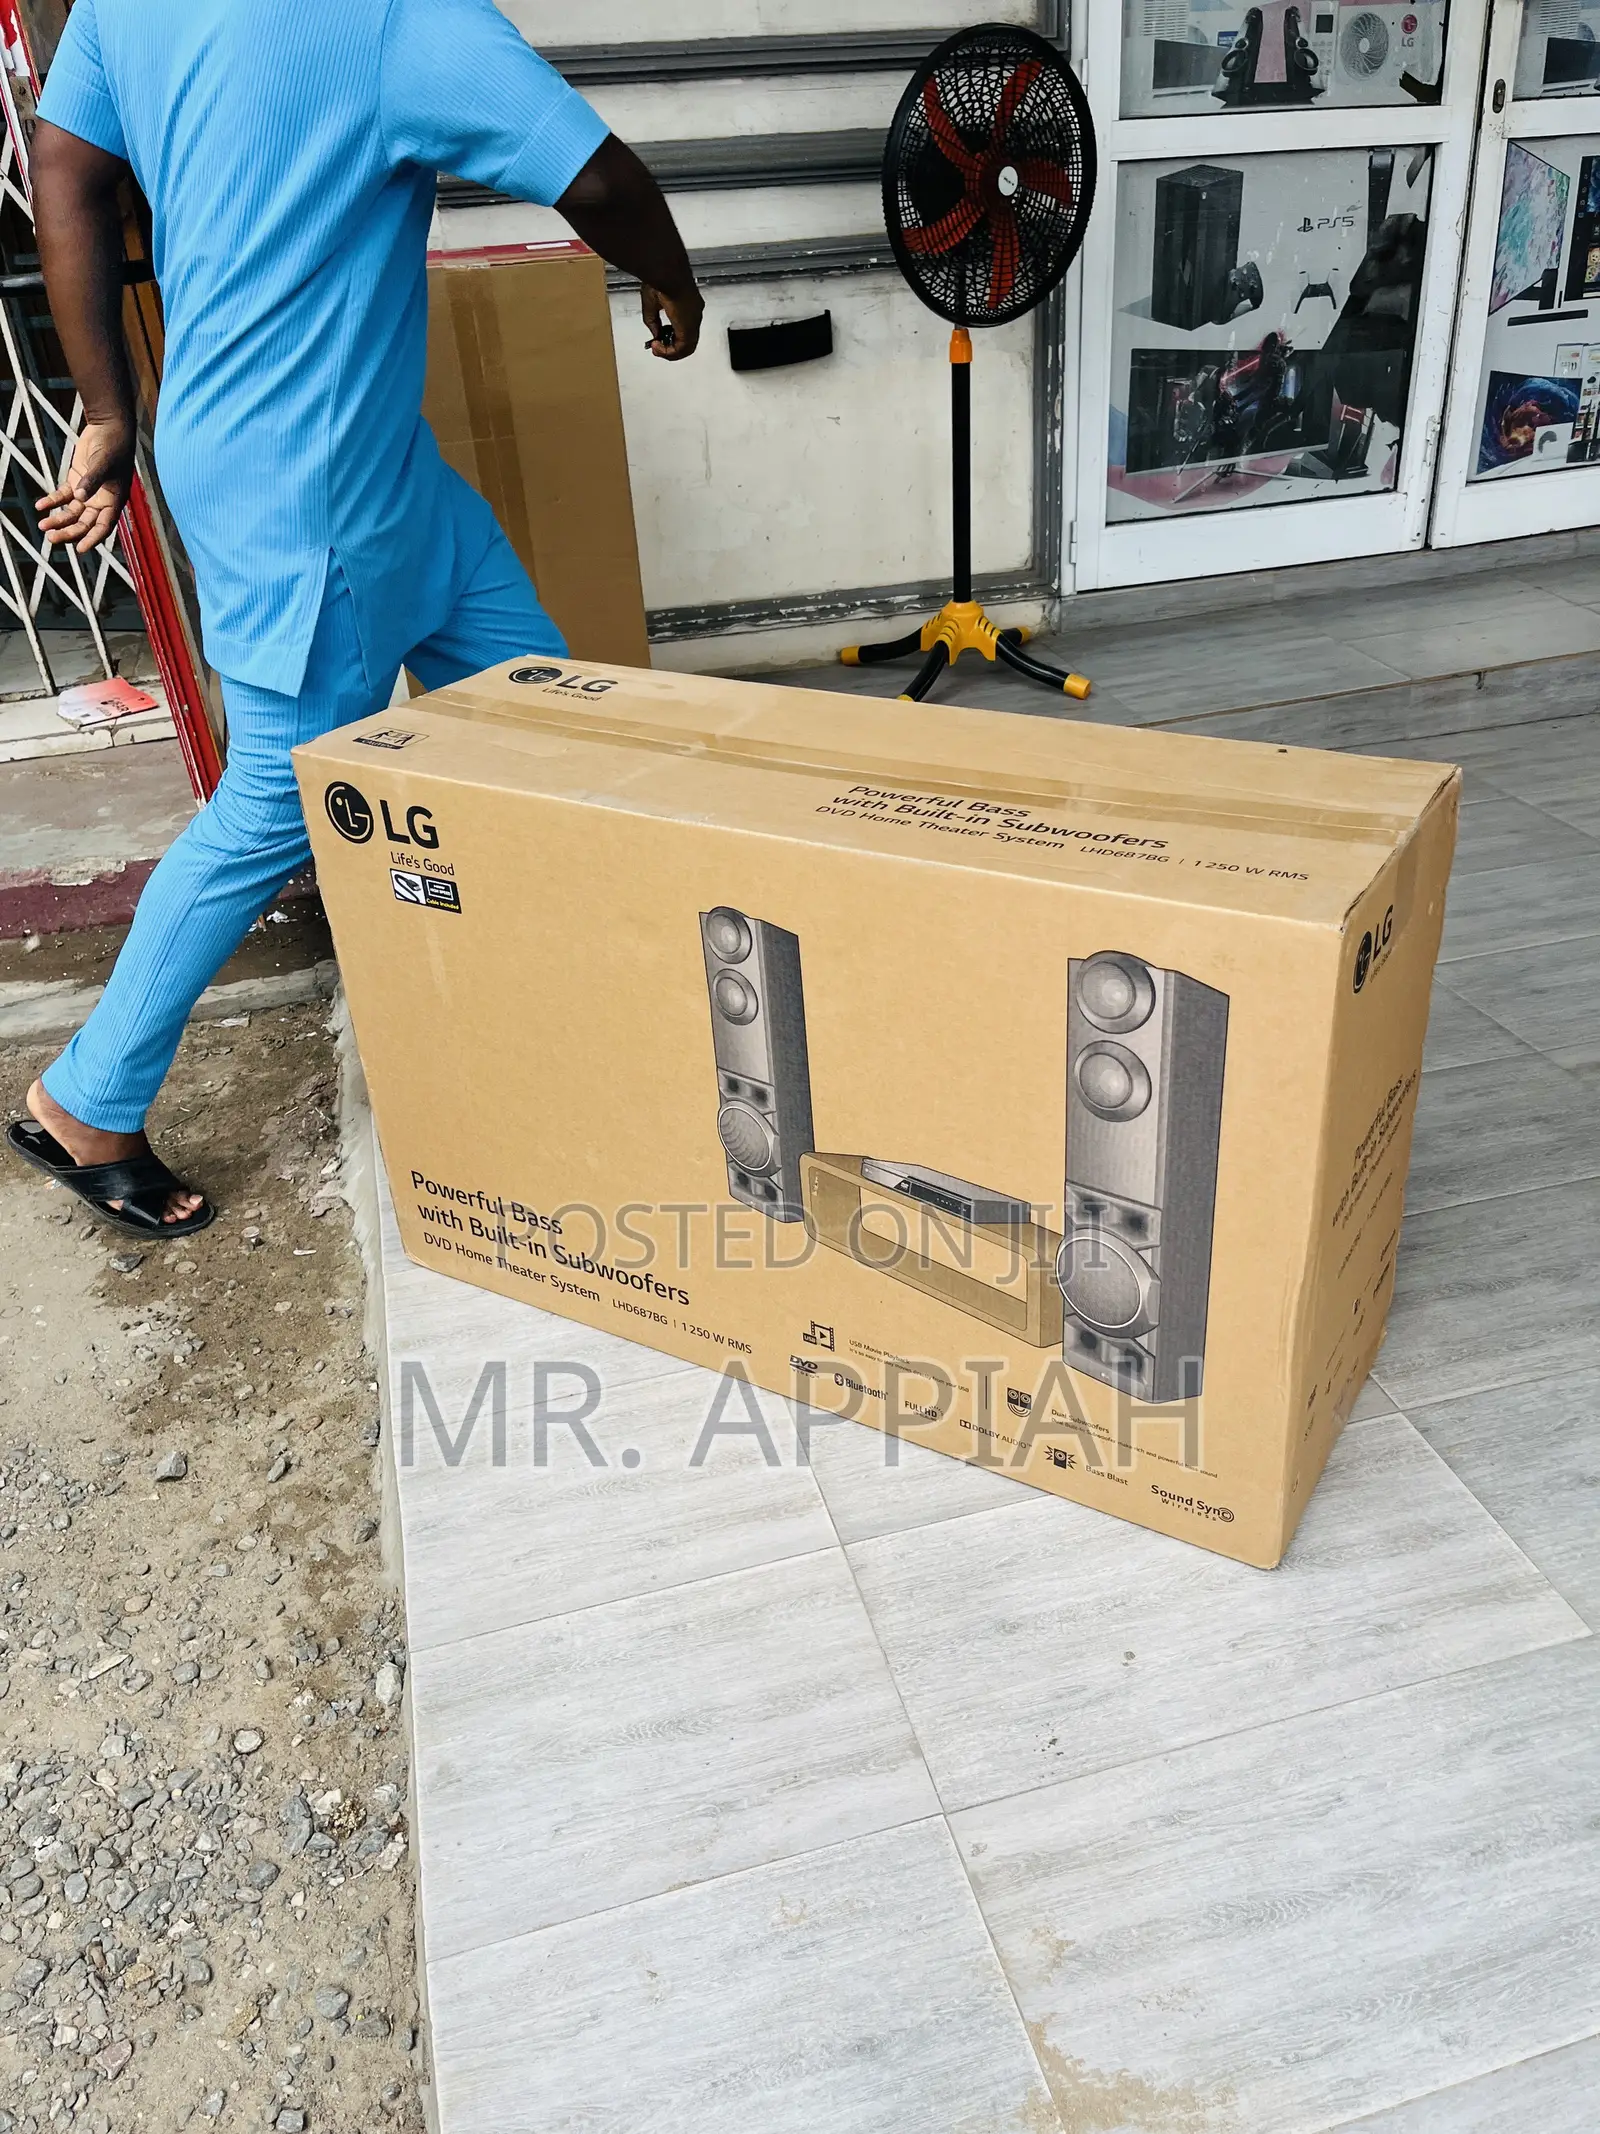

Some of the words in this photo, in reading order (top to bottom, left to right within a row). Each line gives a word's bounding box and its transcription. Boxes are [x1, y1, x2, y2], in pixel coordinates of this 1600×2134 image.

[1401, 37, 1415, 48] LG
[1317, 215, 1355, 230] PS5
[541, 687, 569, 698] Life's
[571, 692, 602, 702] Good
[556, 674, 619, 693] LG
[848, 785, 964, 809] Powerful
[967, 801, 1032, 818] Bass
[379, 799, 440, 850] LG
[832, 796, 888, 811] with
[894, 803, 991, 825] Built-in
[996, 818, 1169, 850] Subwoofers
[814, 805, 856, 817] DVD
[859, 811, 912, 827] Home
[918, 820, 990, 838] Theater
[992, 832, 1065, 850] System
[1080, 846, 1170, 863] LHD687BG
[1245, 865, 1265, 875] W
[1268, 869, 1310, 882] RMS
[390, 851, 421, 869] Life's
[423, 858, 455, 876] Good
[1372, 904, 1394, 962] LG
[410, 1170, 505, 1218] Powerful
[510, 1200, 564, 1236] Bass
[417, 1204, 464, 1232] with
[468, 1216, 548, 1259] Built-in
[552, 1243, 690, 1306] Subwoofers
[423, 1231, 452, 1251] DVD
[455, 1241, 493, 1266] Home
[496, 1255, 547, 1284] Theater
[549, 1274, 601, 1302] System
[612, 1298, 668, 1326] LHD687BG
[712, 1331, 725, 1345] W
[727, 1337, 753, 1355] RMS
[789, 1354, 819, 1370] DVD
[848, 1339, 863, 1349] USB
[863, 1344, 883, 1356] Movie
[883, 1350, 911, 1366] Playback
[1051, 1408, 1067, 1420] Dual
[1068, 1413, 1110, 1435] Subwoofers
[1085, 1464, 1106, 1479] Bass
[1106, 1471, 1129, 1486] Blast
[1150, 1484, 1193, 1507] Sound
[1196, 1499, 1235, 1524] Sync
[1161, 1497, 1217, 1522] Wireless
